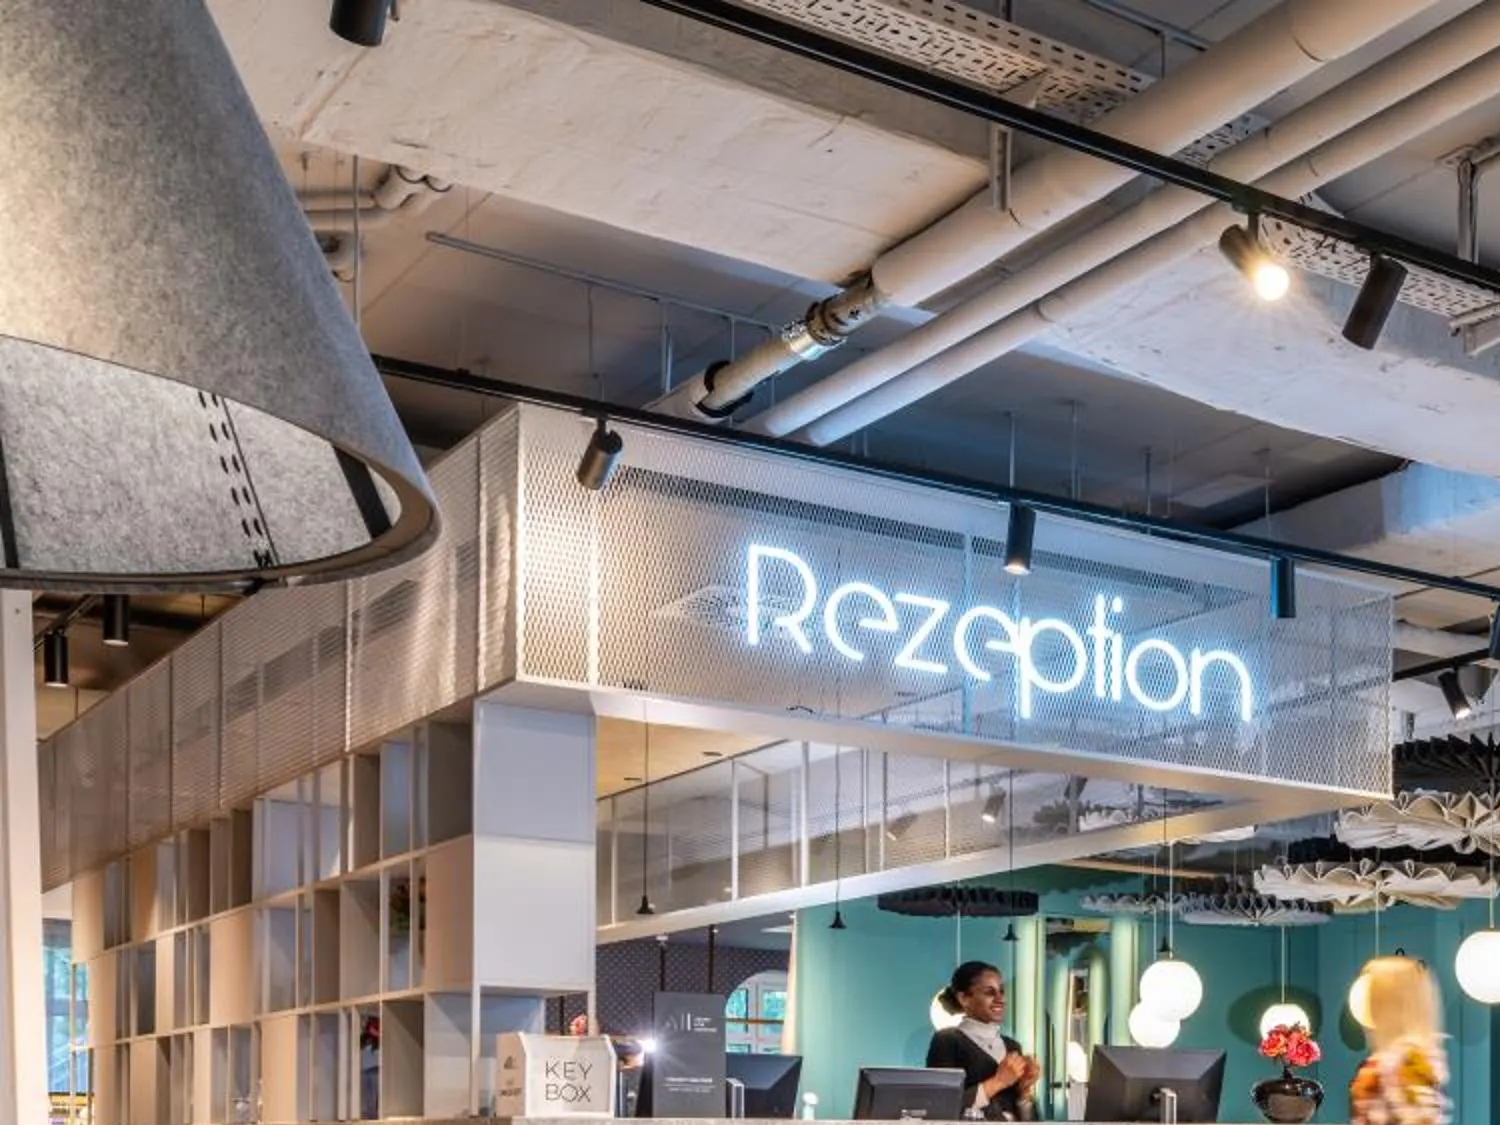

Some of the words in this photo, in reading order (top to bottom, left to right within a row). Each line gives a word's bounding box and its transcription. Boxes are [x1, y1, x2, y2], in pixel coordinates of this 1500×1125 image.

[746, 543, 1252, 722] Rezeption
[545, 1060, 593, 1081] KEY
[544, 1083, 592, 1103] BOX
